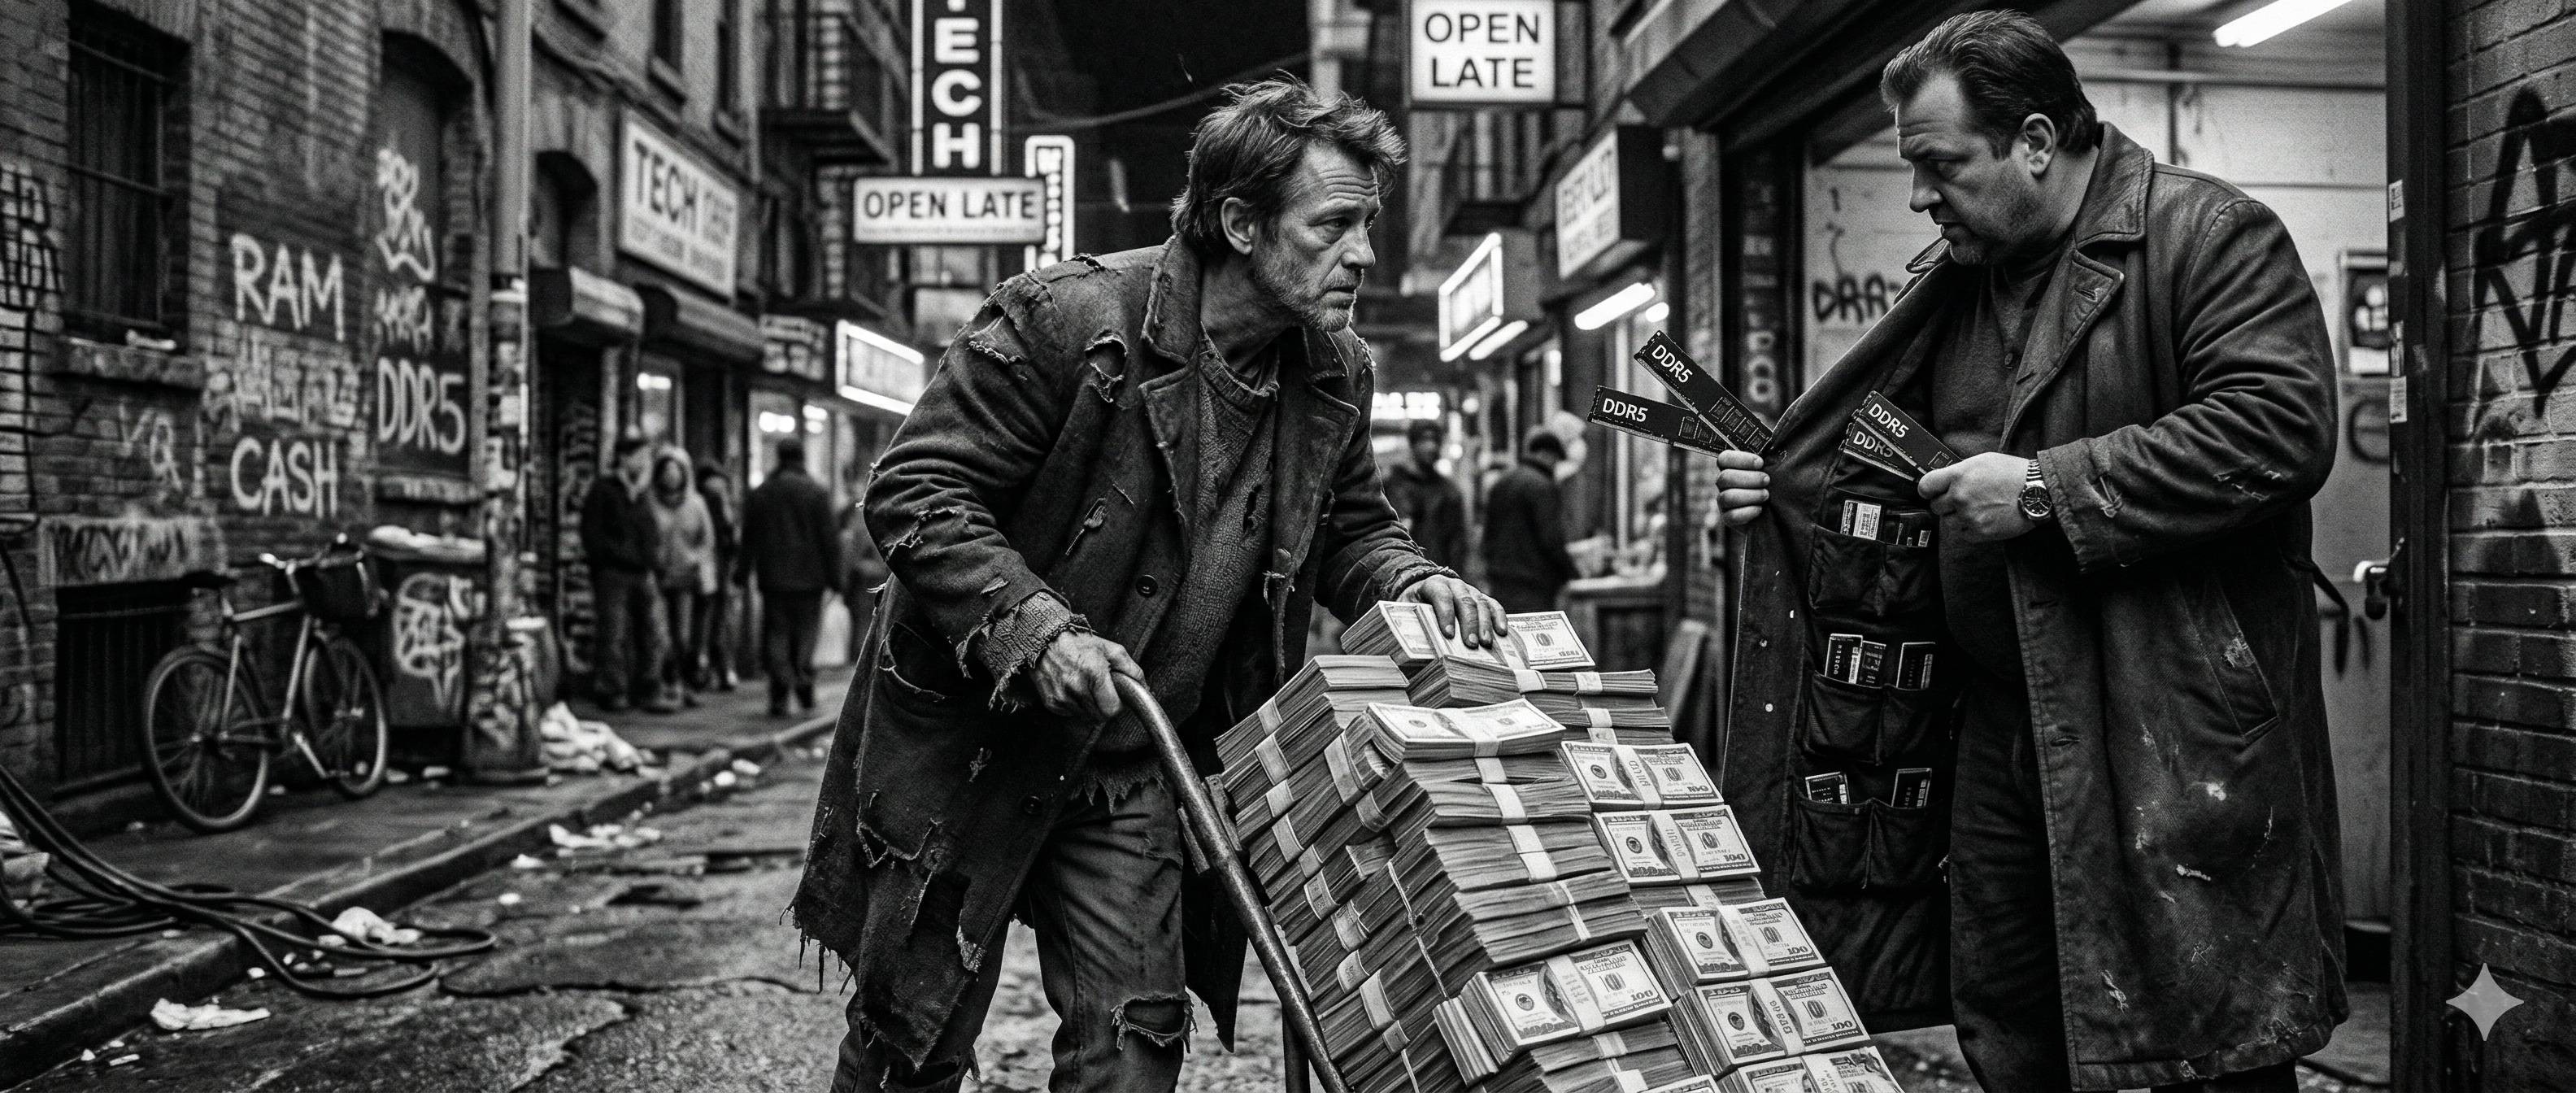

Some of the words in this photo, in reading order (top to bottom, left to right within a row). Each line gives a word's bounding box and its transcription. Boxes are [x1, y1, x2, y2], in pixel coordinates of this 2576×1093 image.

[1425, 13, 1538, 43] OPEN
[932, 0, 981, 168] ECH
[1432, 57, 1534, 88] LATE
[634, 139, 698, 234] TECH
[864, 190, 946, 219] OPEN
[962, 190, 1036, 219] LATE
[230, 233, 343, 342] RAM
[1651, 344, 1693, 384] DDR5
[377, 357, 466, 455] DDR5
[1602, 398, 1649, 423] DDR5
[1868, 403, 1910, 438] DDR5
[230, 437, 338, 519] CASH
[1724, 852, 1746, 862] 100
[1787, 945, 1809, 956] 100
[1630, 989, 1654, 1002] 100
[1830, 1020, 1853, 1032] 100
